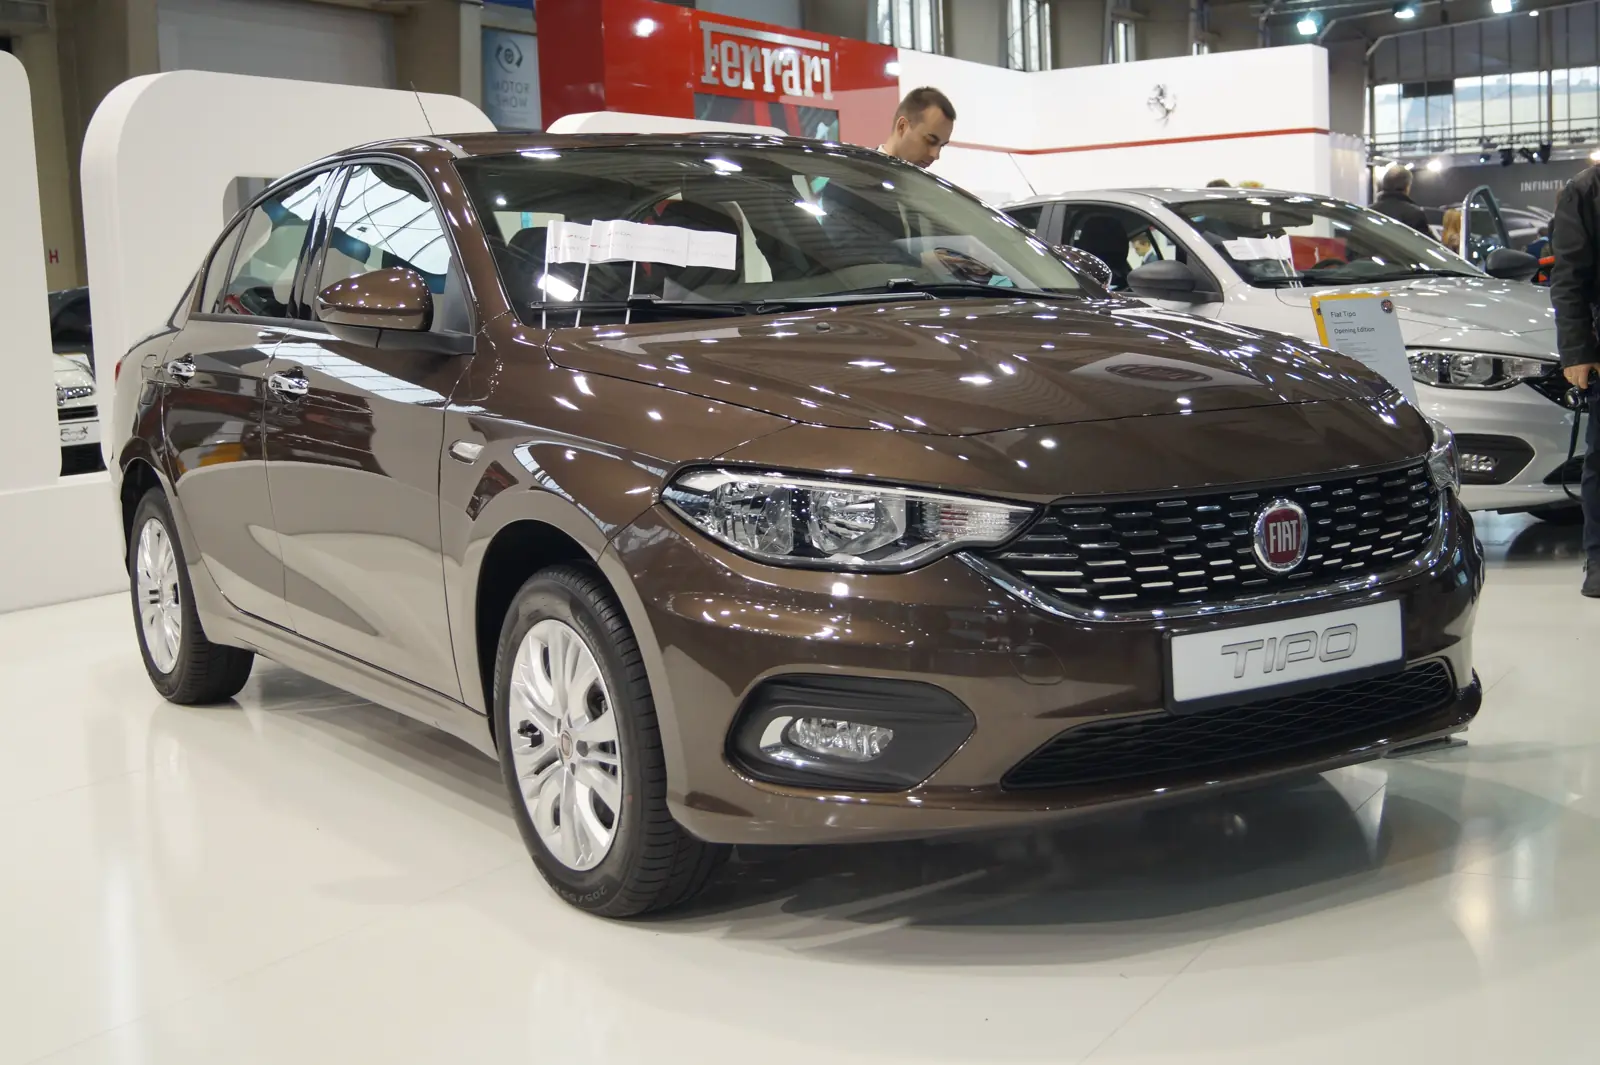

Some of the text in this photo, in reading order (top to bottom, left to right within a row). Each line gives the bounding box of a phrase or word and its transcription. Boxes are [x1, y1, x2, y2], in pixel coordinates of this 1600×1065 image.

[699, 20, 833, 100] Ferrari
[496, 94, 528, 108] SHOW
[49, 248, 59, 264] H
[1343, 310, 1356, 318] Tipo
[1268, 519, 1298, 554] FIAT
[1220, 623, 1358, 679] TIPO
